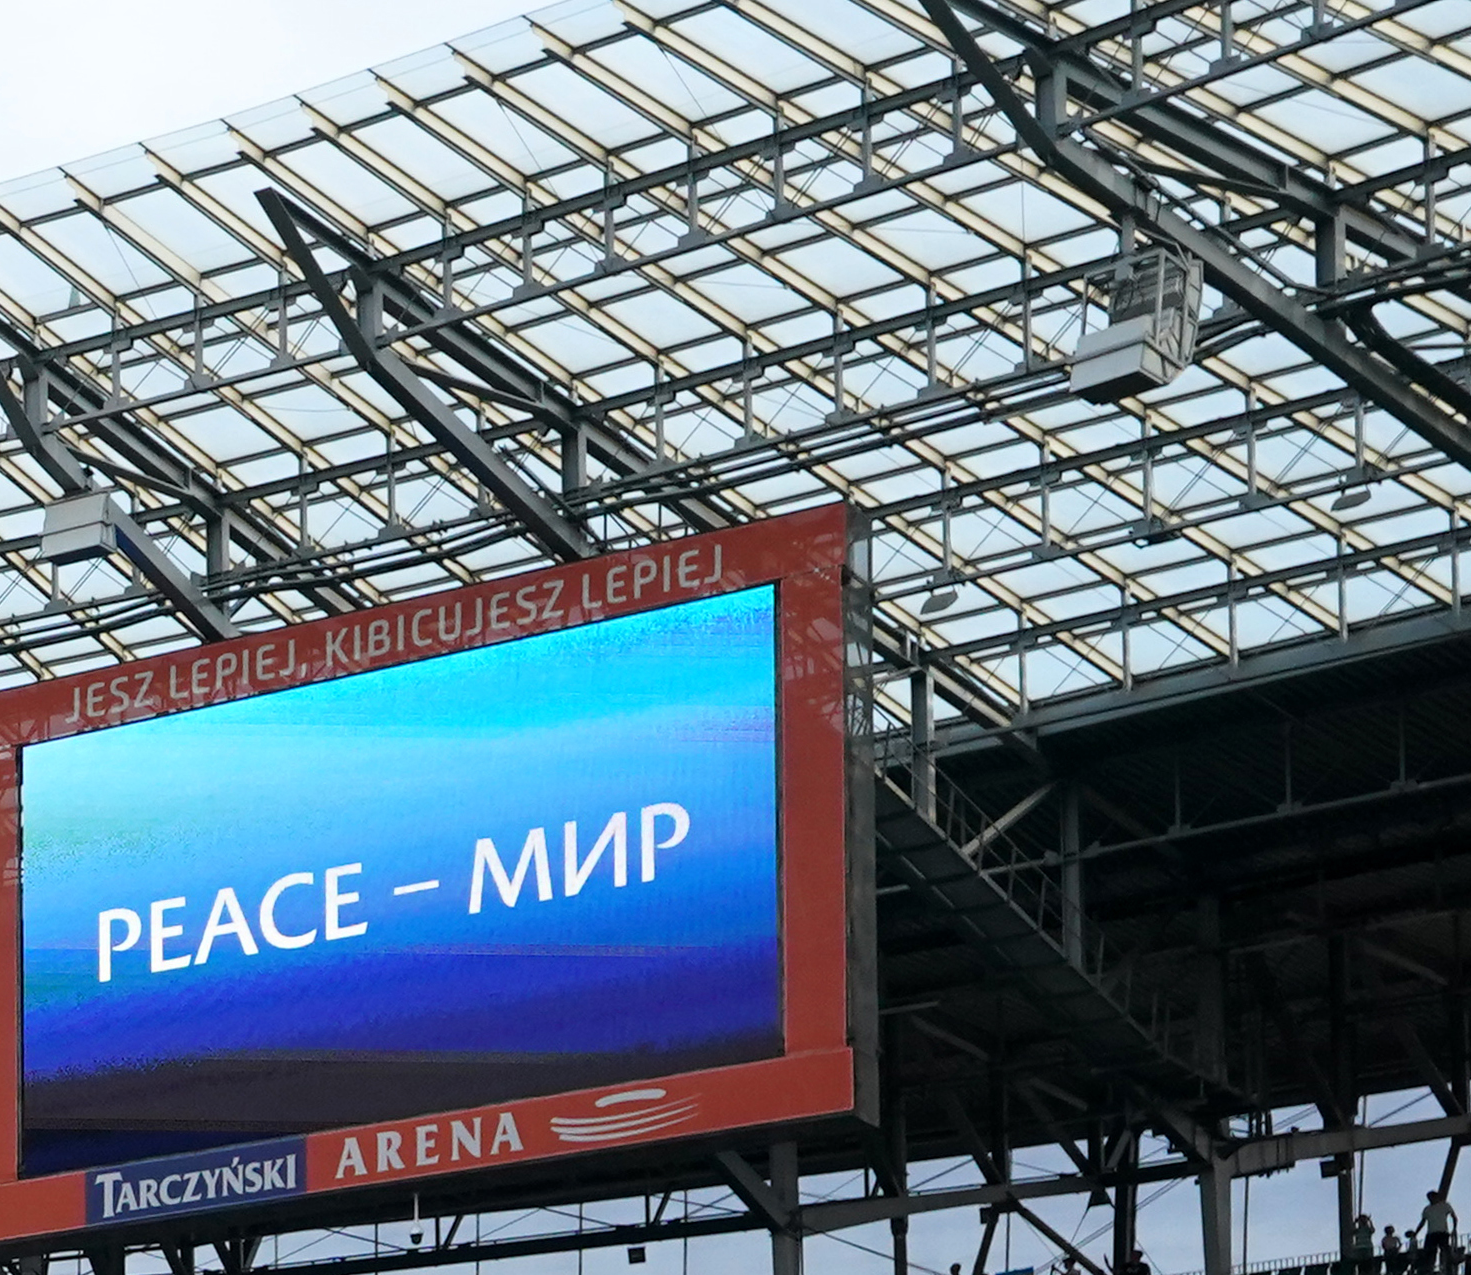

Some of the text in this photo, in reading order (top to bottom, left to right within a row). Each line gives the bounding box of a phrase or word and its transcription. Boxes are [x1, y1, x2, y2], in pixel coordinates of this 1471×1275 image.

[64, 672, 153, 725] JESZ
[325, 583, 566, 666] KIBICUJESZ
[582, 545, 724, 612] LEPIEJ
[96, 860, 369, 983] PEACE
[467, 800, 692, 917] МИР
[335, 1110, 524, 1181] ARENA
